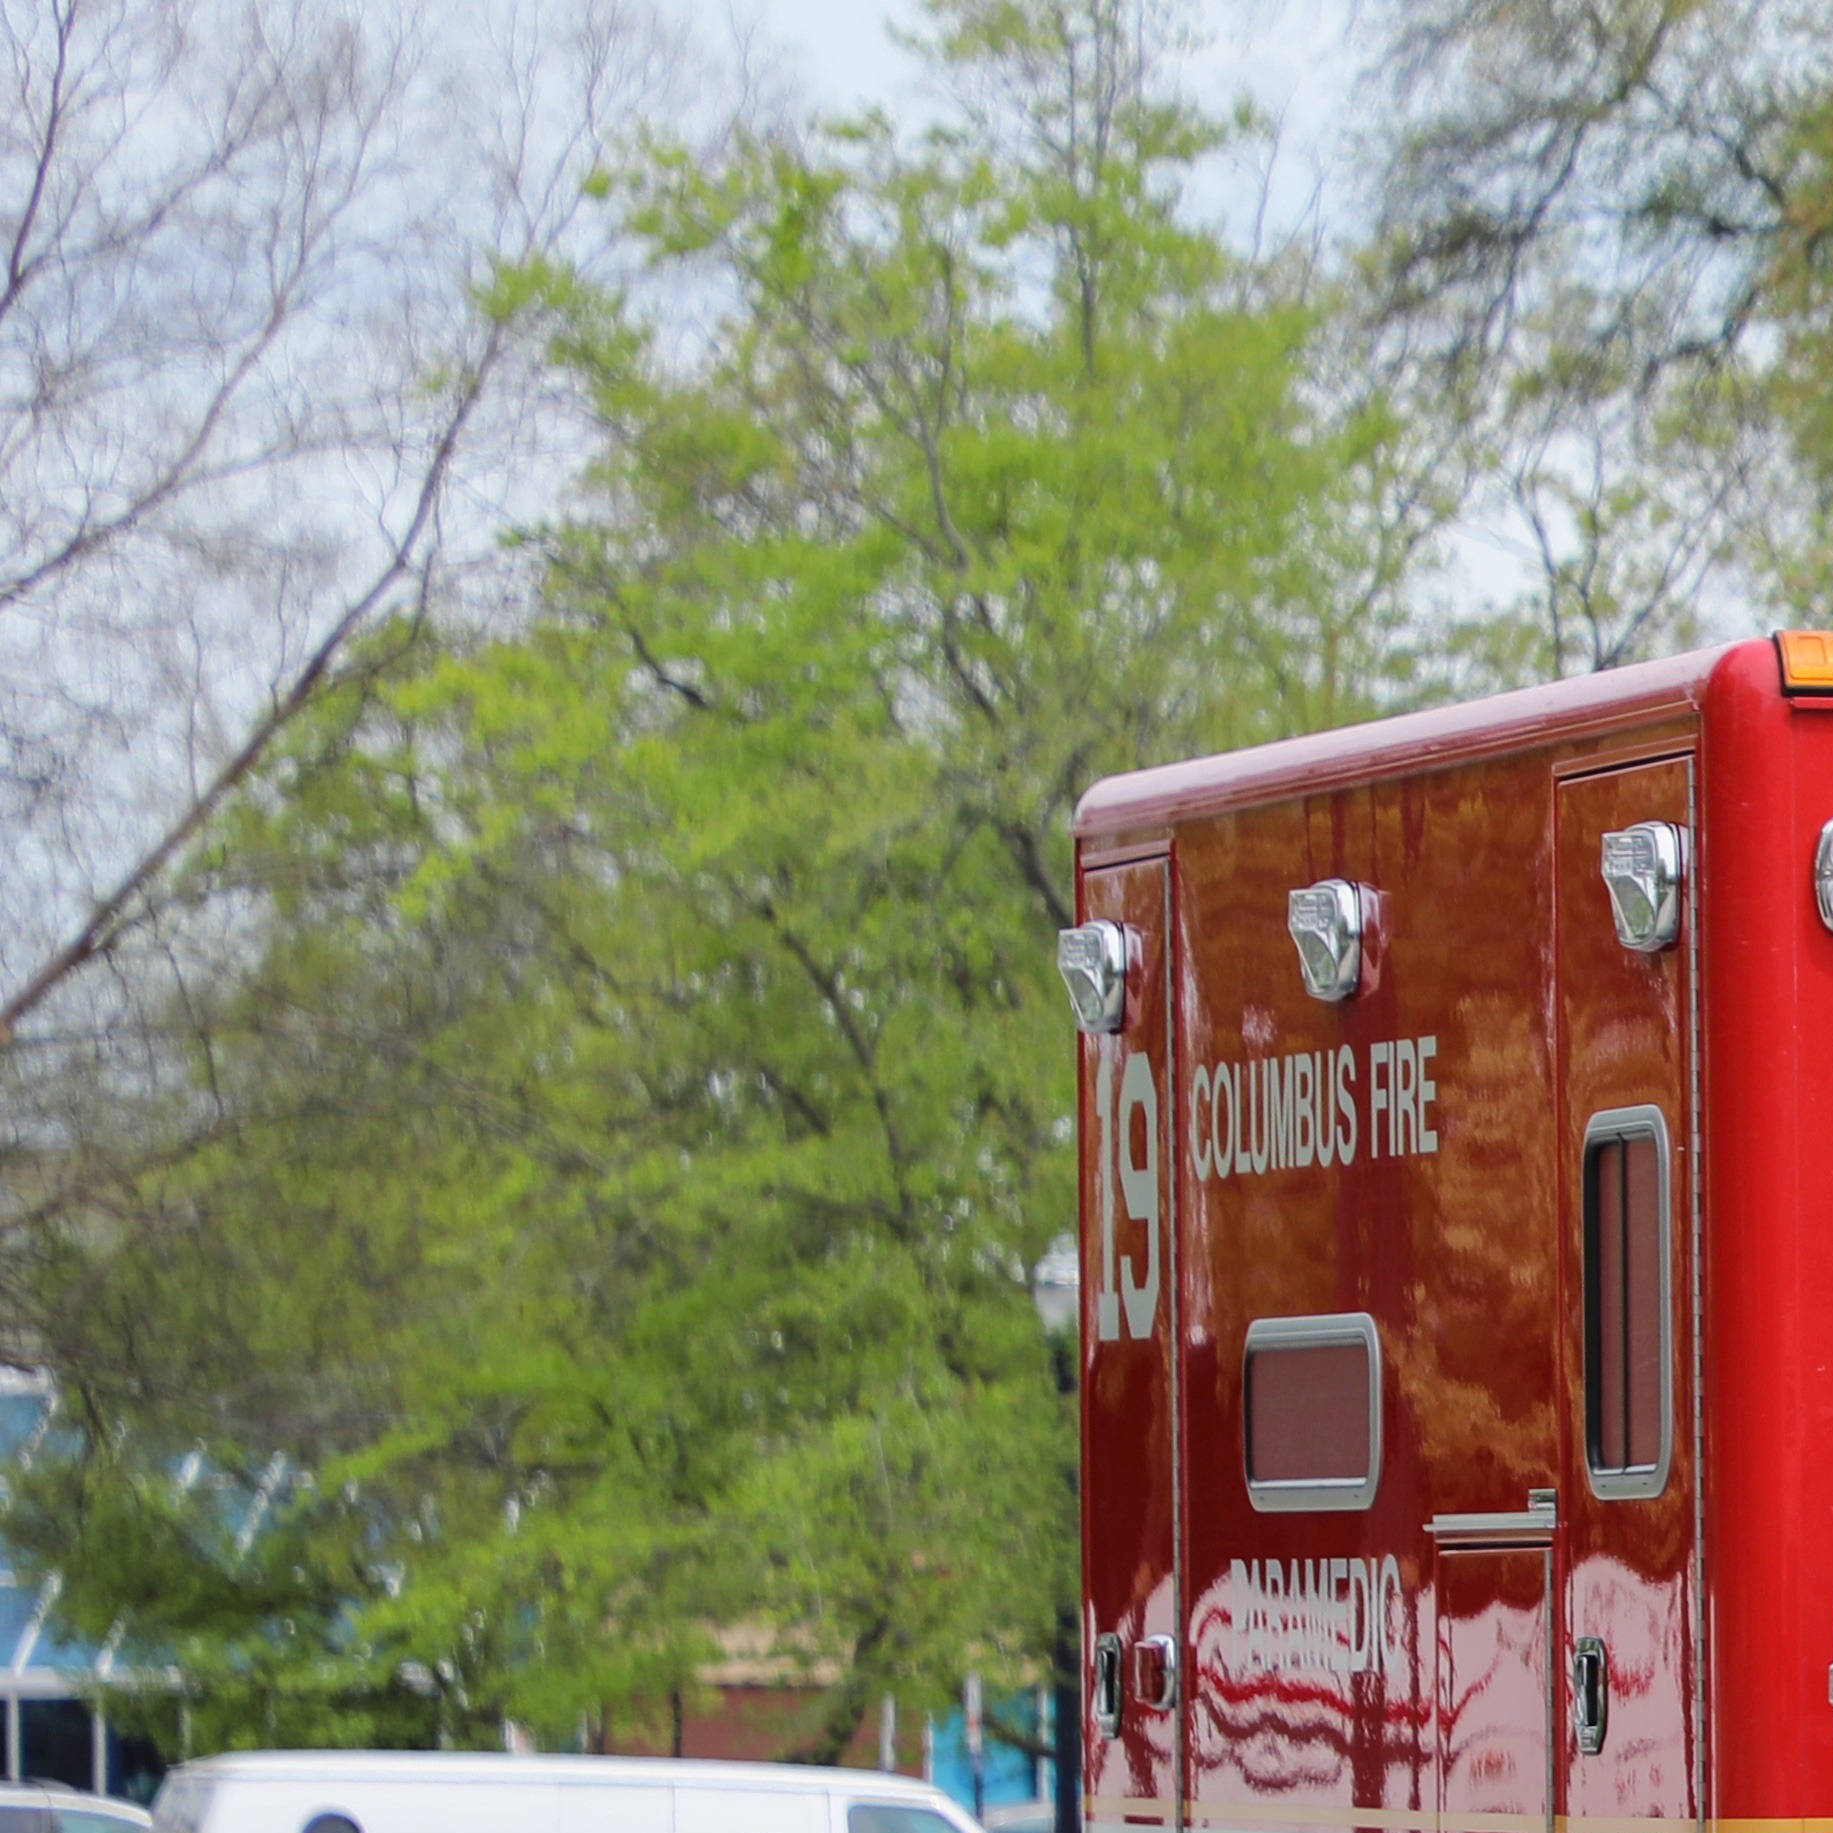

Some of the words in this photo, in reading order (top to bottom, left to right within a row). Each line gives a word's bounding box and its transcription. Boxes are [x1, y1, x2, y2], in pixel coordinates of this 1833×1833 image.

[1191, 1043, 1358, 1183] COLUMBUS
[1369, 1034, 1439, 1160] FIRE
[1096, 1050, 1160, 1342] 19
[1230, 1554, 1402, 1676] PARAMEDIC
